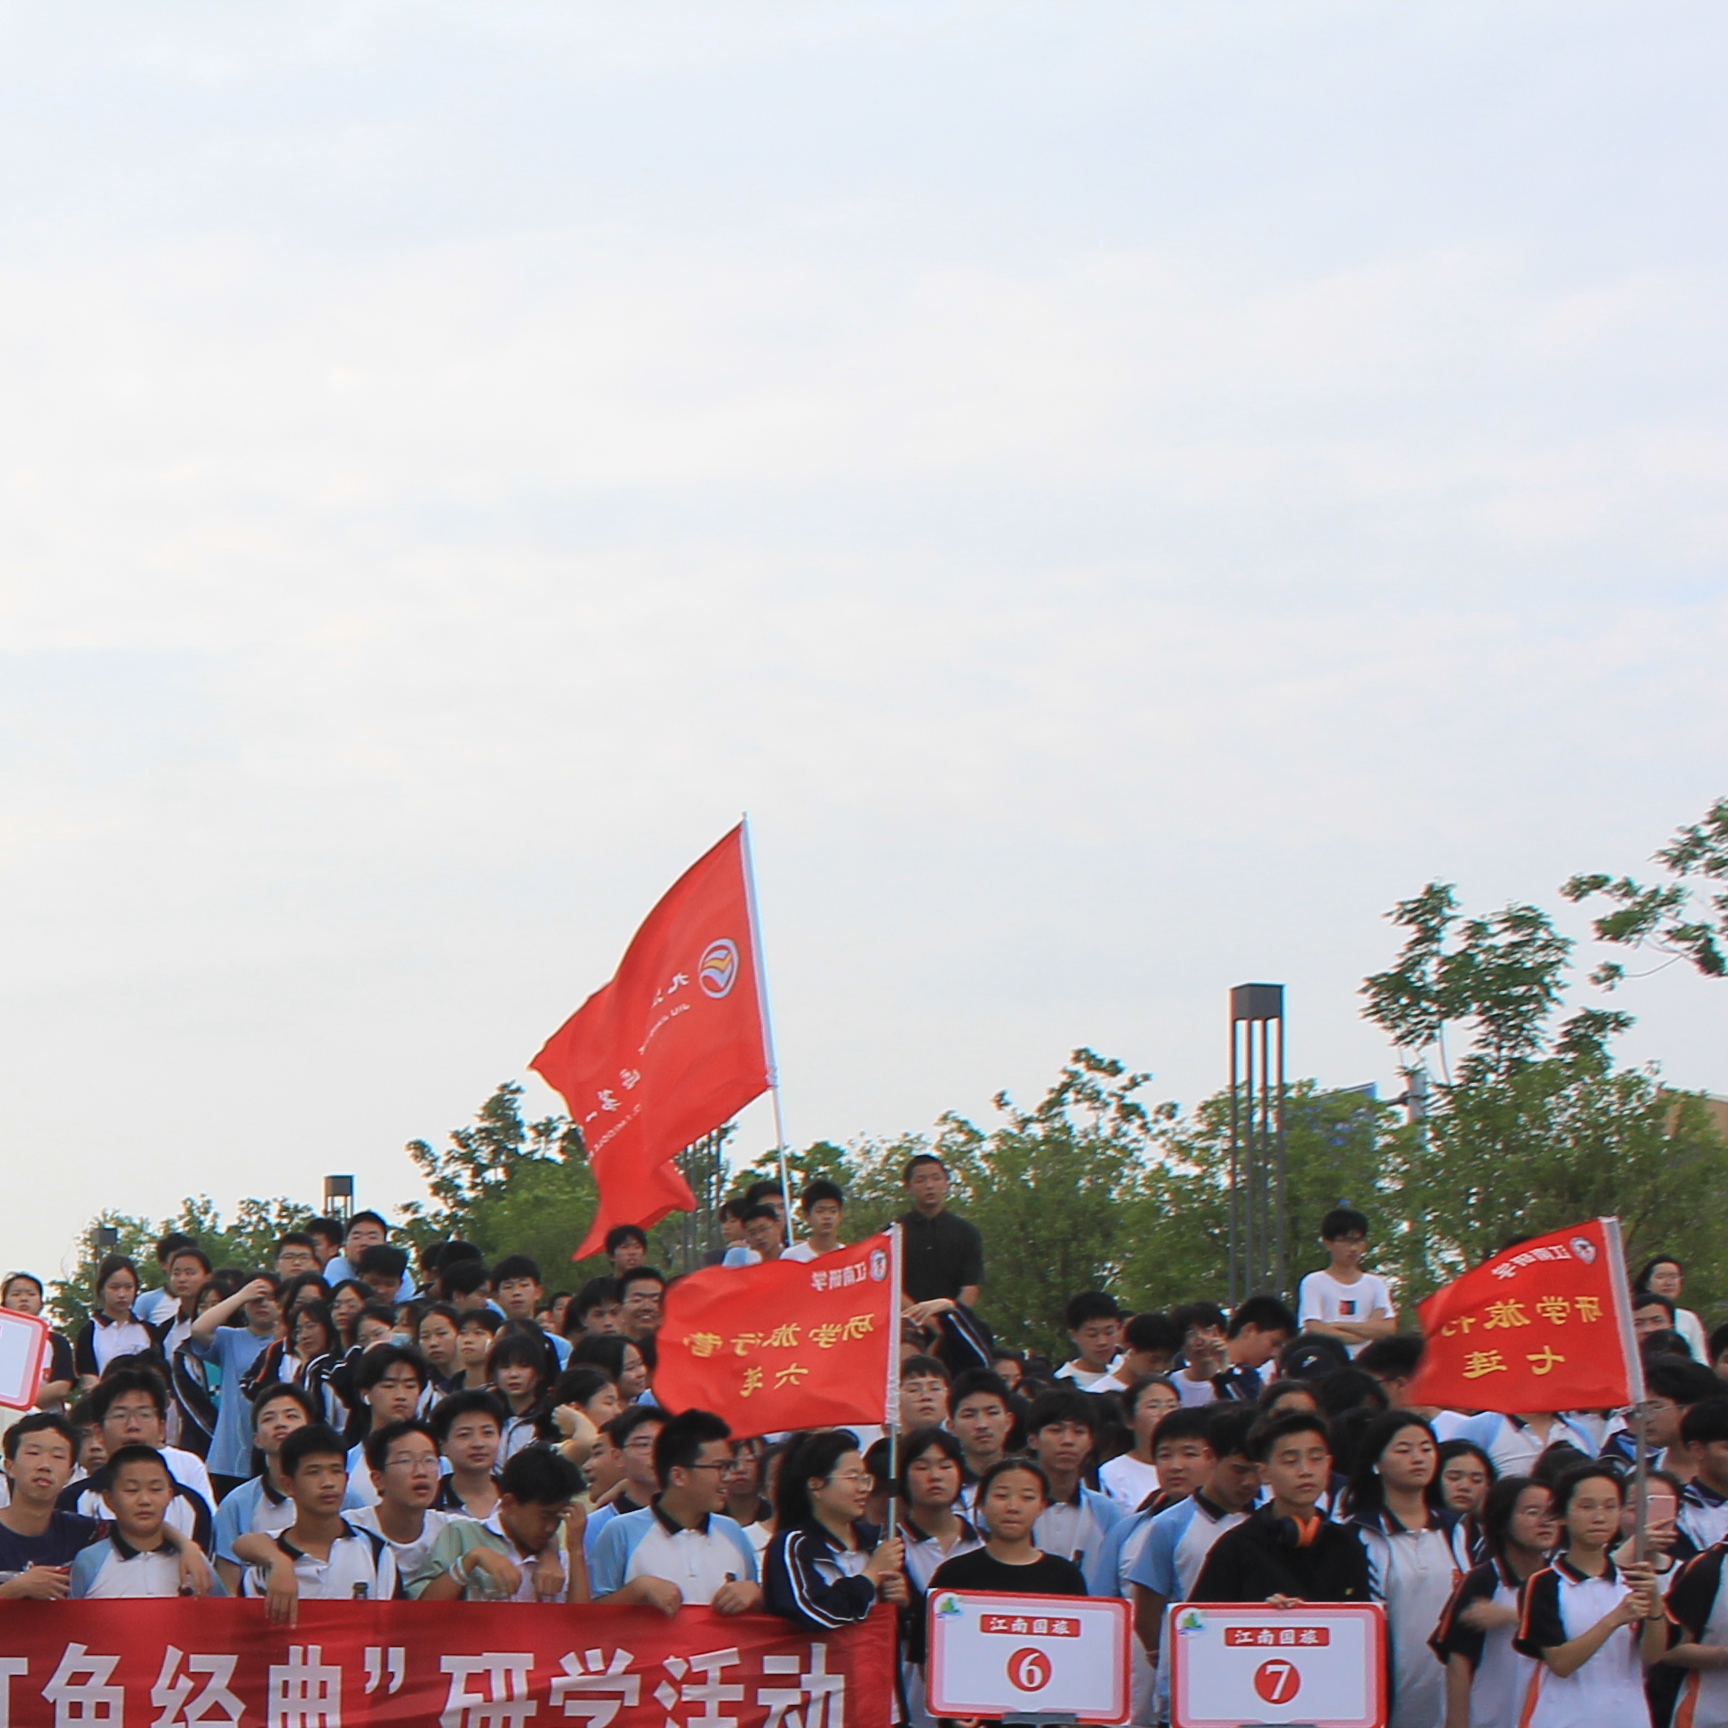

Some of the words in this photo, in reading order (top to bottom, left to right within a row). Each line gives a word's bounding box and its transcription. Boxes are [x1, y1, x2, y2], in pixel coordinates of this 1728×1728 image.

[989, 1617, 1071, 1635] 江南国旅
[1234, 1628, 1320, 1645] 江南国旅
[1018, 1652, 1044, 1688] 6
[1265, 1664, 1292, 1700] 7
